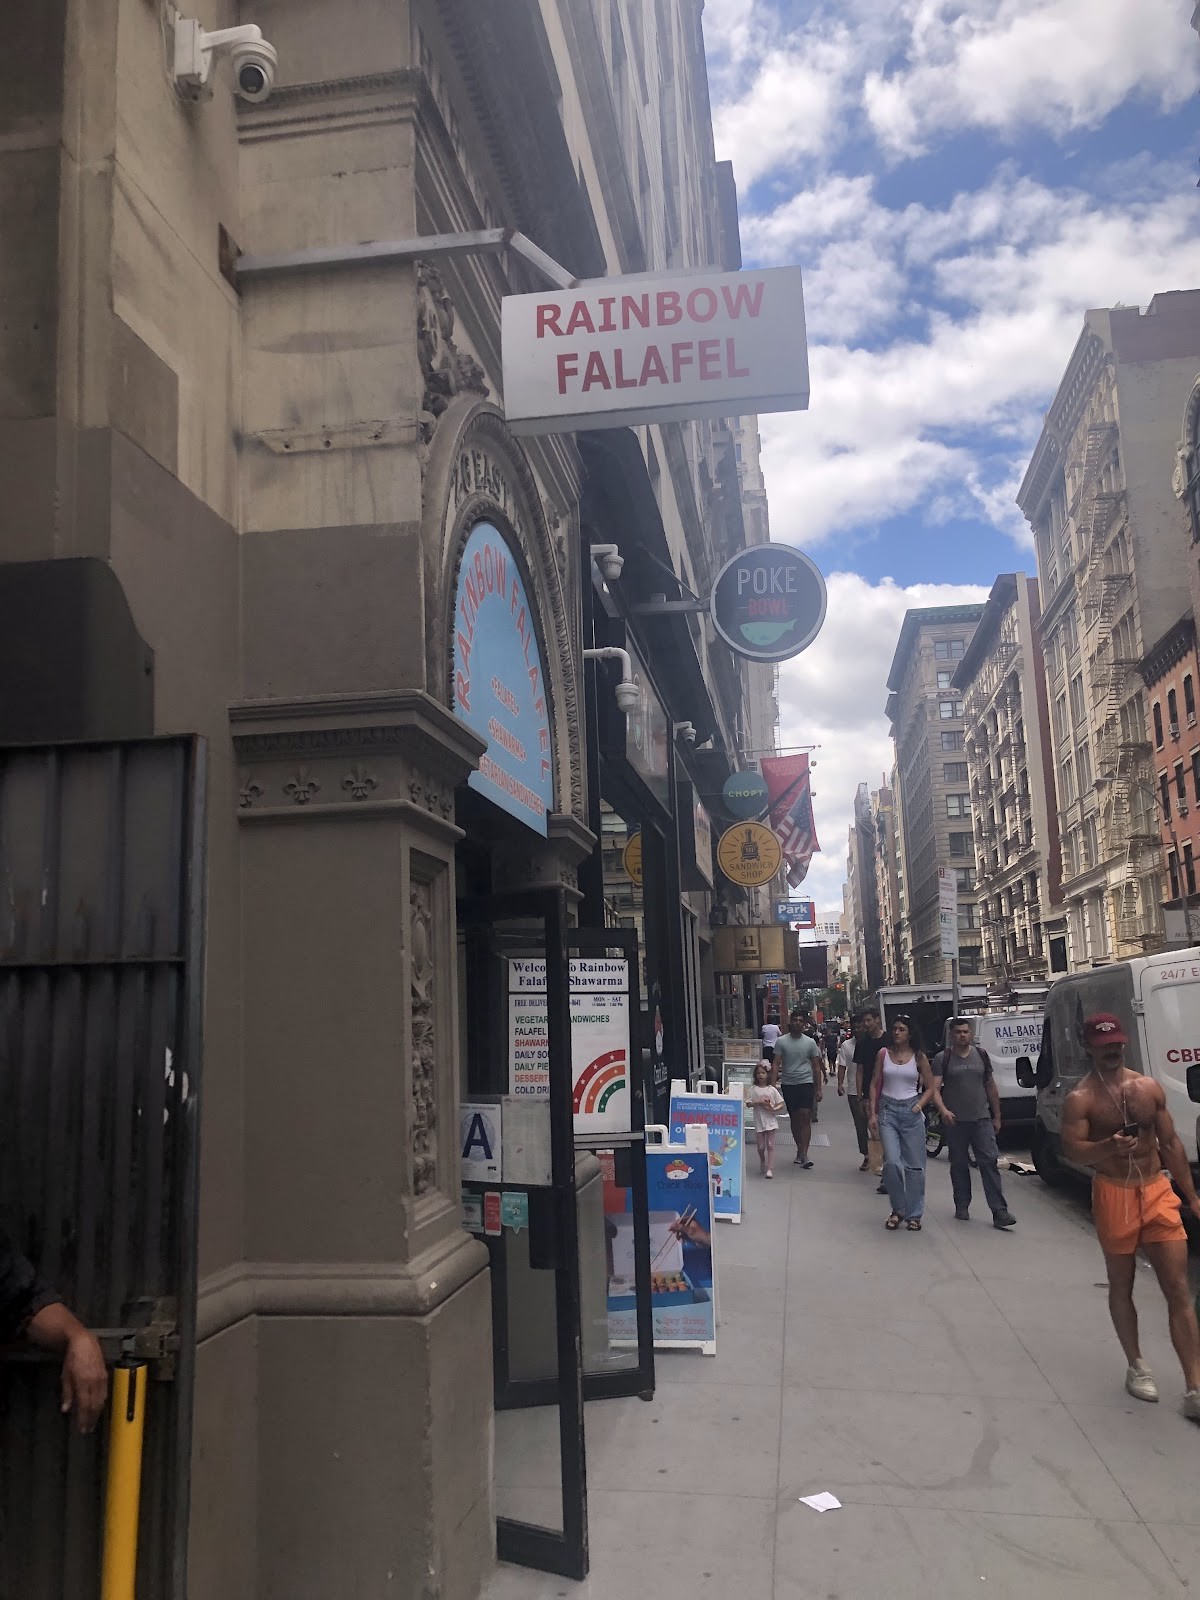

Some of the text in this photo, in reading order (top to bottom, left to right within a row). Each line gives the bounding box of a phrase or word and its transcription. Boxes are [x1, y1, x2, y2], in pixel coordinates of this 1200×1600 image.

[536, 282, 765, 338] RAINBOW
[557, 337, 750, 394] FALAFEL
[737, 567, 798, 595] POKE
[749, 598, 790, 615] BOWL
[453, 543, 507, 714] RAINBOW
[510, 578, 552, 782] FALAFEL
[728, 788, 764, 798] CHOPT
[729, 861, 774, 871] SANDWICH
[741, 871, 762, 879] SHOP
[778, 903, 808, 914] Park
[513, 962, 546, 973] Welco
[580, 962, 626, 972] Rainbow
[1160, 968, 1186, 980] 24/7
[519, 975, 624, 986] Falaf Shawarma
[515, 1015, 610, 1024] VEGETAR NDWICHES
[514, 1027, 547, 1036] FALAFEL
[995, 1024, 1036, 1038] RAL-BAR
[514, 1051, 536, 1059] DAILY
[1001, 1045, 1020, 1055] (718)
[514, 1063, 536, 1071] DAILY
[514, 1075, 549, 1083] DESSERT
[537, 1086, 550, 1094] DRI
[672, 1111, 738, 1128] FRANCHISE
[462, 1113, 493, 1160] A
